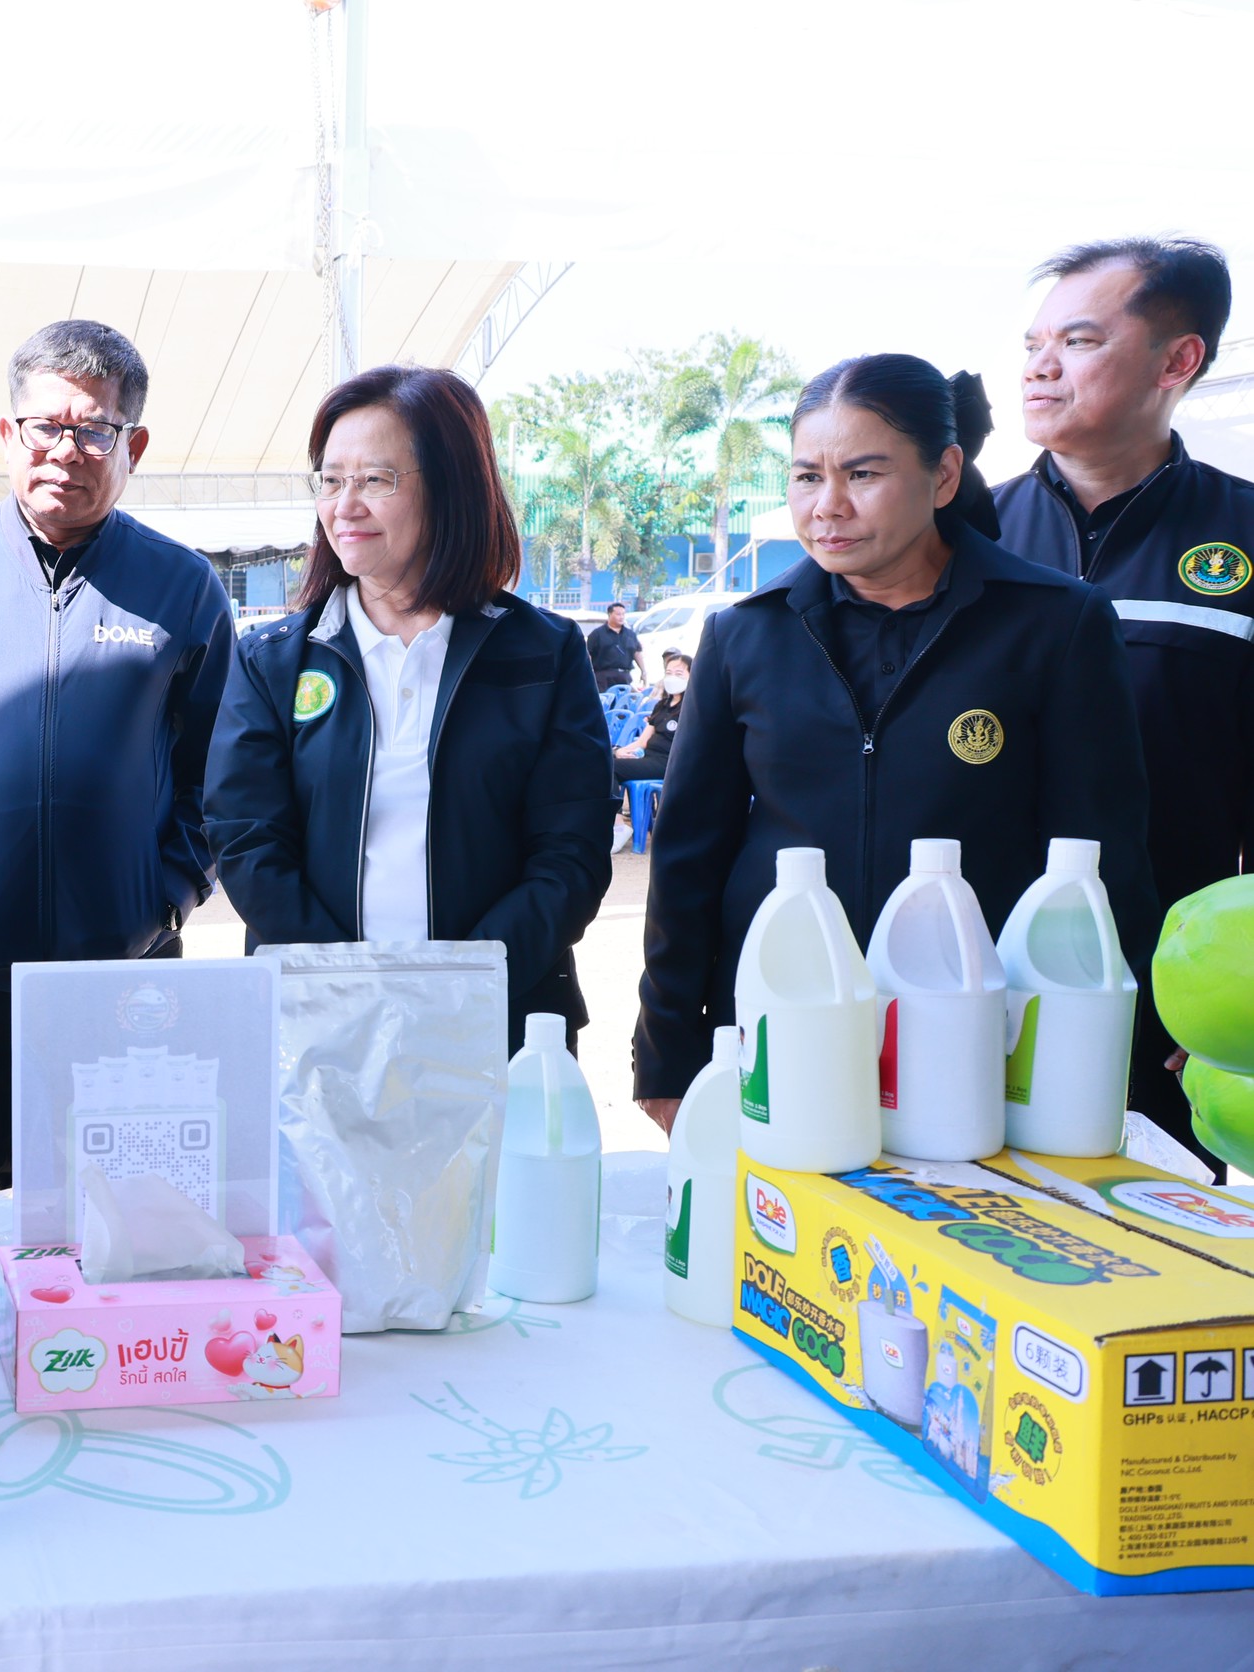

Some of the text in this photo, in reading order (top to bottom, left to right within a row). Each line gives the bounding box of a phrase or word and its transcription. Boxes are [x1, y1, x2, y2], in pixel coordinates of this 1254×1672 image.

[94, 625, 155, 646] DOAE
[756, 1188, 787, 1225] Dole
[12, 1247, 78, 1260] Zilk
[745, 1253, 785, 1302] DOLE
[742, 1283, 790, 1336] MAGIC
[42, 1348, 96, 1373] Zilk
[117, 1328, 189, 1367] แฮปปี้
[793, 1317, 844, 1377] COCO
[154, 1368, 187, 1383] สดใส
[1123, 1413, 1164, 1426] GHPs
[1197, 1407, 1250, 1422] HACCP
